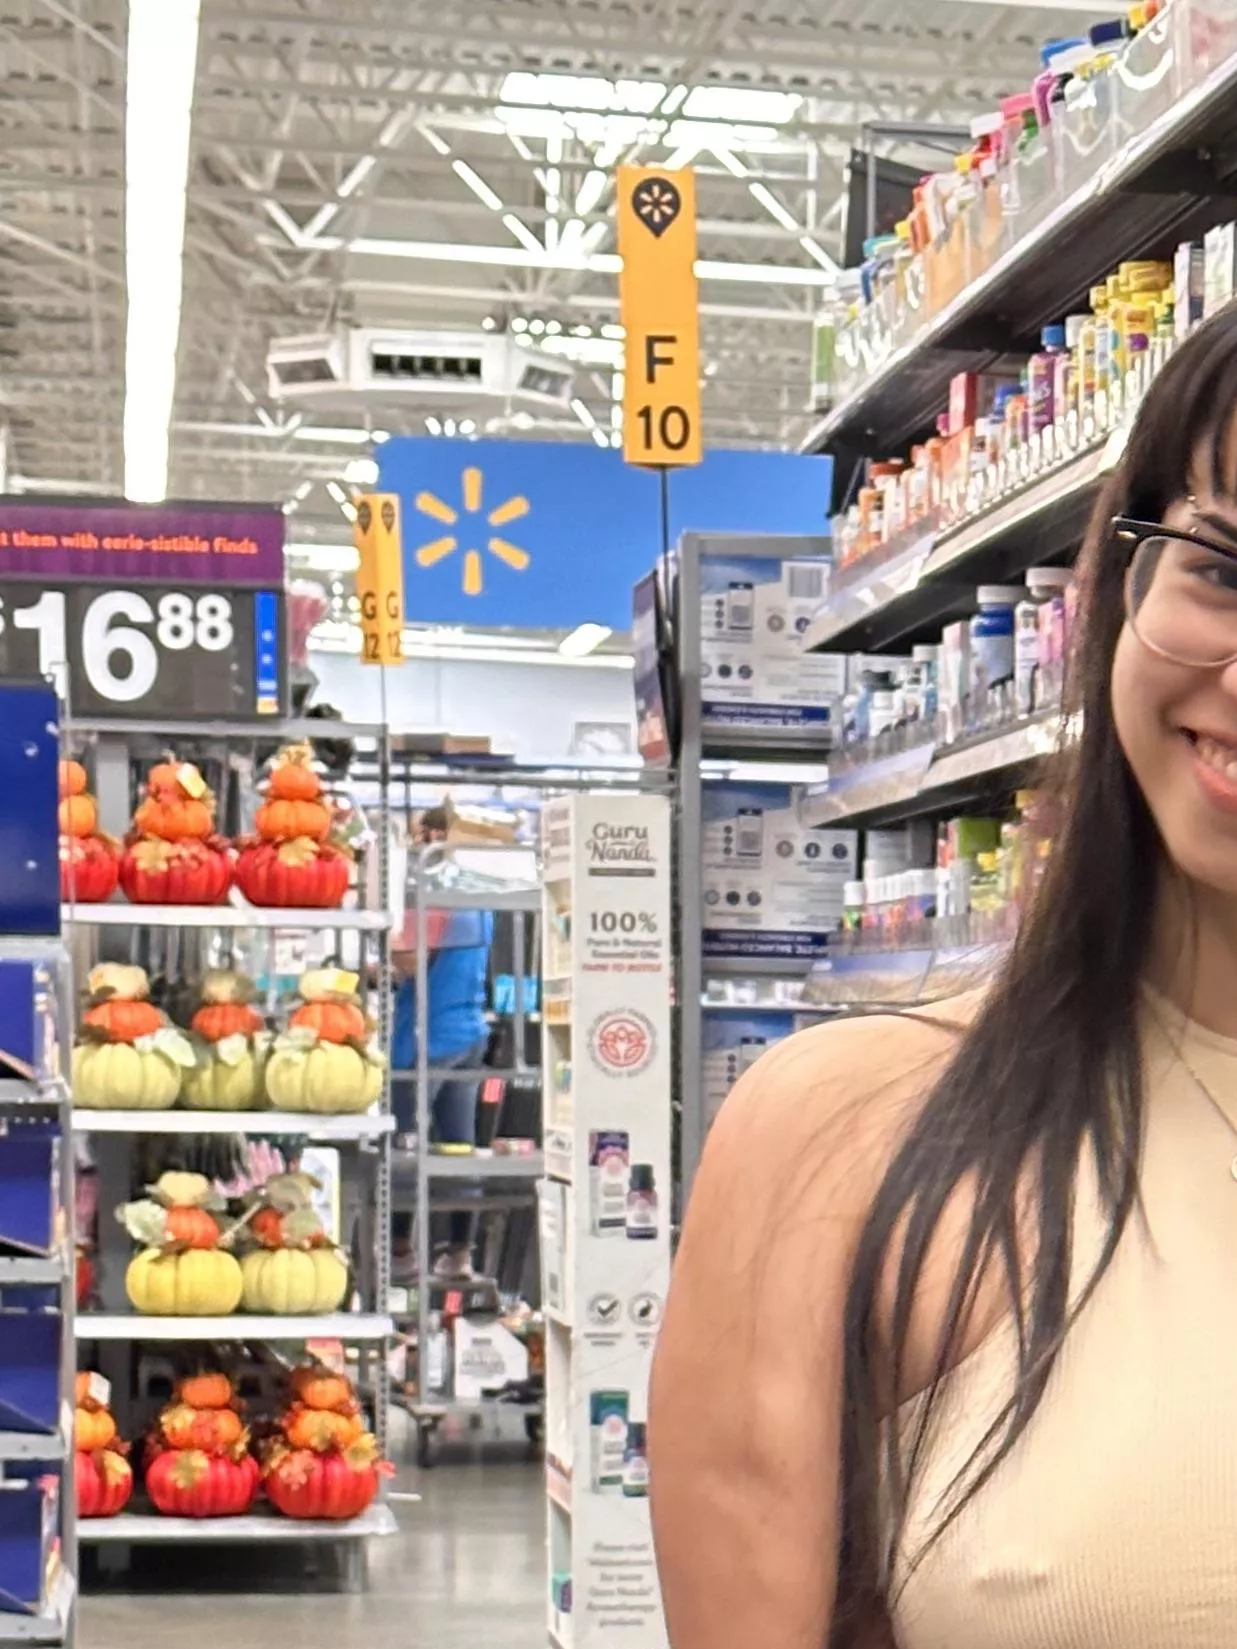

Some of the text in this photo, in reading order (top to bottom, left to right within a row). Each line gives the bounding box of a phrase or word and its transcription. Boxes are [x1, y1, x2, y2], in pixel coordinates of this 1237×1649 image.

[644, 336, 677, 385] F
[635, 404, 691, 453] 10
[13, 529, 58, 549] them
[61, 531, 98, 550] with
[212, 537, 259, 555] finds
[361, 591, 377, 621] G
[386, 590, 399, 619] G
[363, 632, 379, 660] 12
[592, 821, 649, 840] Guru
[584, 838, 656, 862] Nanda
[590, 911, 658, 934] 100%
